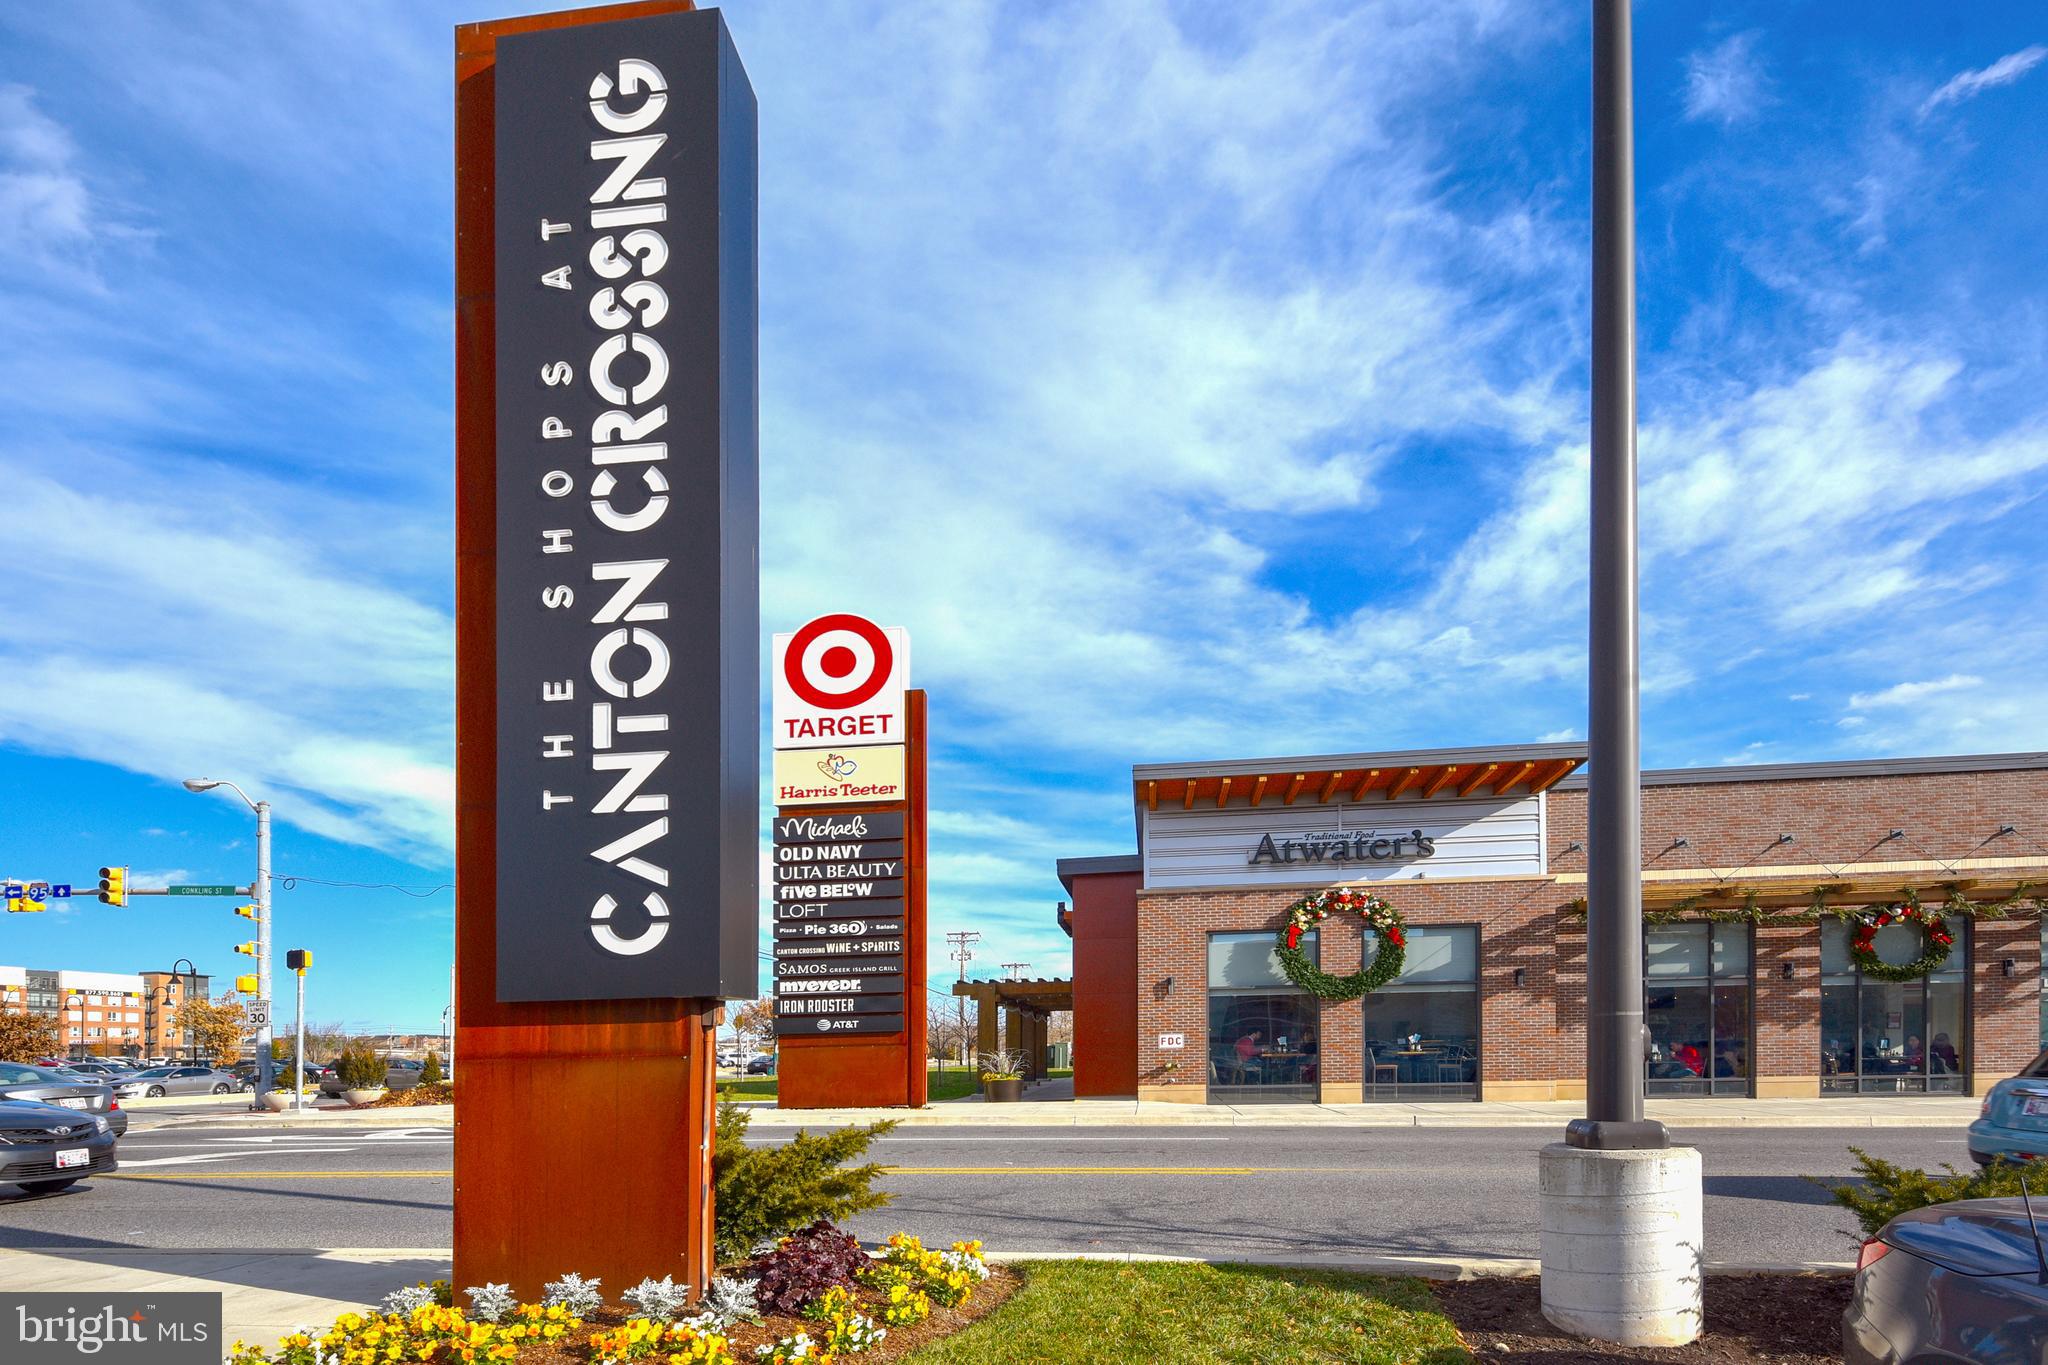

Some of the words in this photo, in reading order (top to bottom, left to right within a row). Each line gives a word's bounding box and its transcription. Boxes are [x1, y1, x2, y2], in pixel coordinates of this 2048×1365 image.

[541, 218, 572, 291] AT
[589, 57, 670, 532] CROSSING
[541, 360, 574, 609] SHOPS
[784, 714, 893, 739] TARGET
[541, 679, 574, 811] THE
[590, 558, 670, 956] CANTON
[780, 785, 838, 799] Harris
[840, 783, 897, 797] Teeter
[780, 815, 868, 840] Michaels
[1304, 832, 1352, 841] Traditional
[1354, 830, 1376, 839] Food
[780, 847, 814, 861] OLD
[817, 845, 863, 860] NAVY
[1248, 829, 1436, 864] Atwater's
[780, 865, 823, 880] ULTA
[826, 862, 897, 878] BEAUTY
[30, 887, 48, 899] 95
[181, 887, 213, 895] CONKLING
[215, 887, 223, 895] ST
[820, 883, 873, 898] BELOW
[780, 903, 829, 918] LOFT
[804, 924, 827, 935] Pie
[778, 963, 827, 975] SAMOS
[779, 1000, 805, 1014] IRON
[807, 998, 855, 1013] ROOSTER
[250, 1013, 266, 1024] 30
[832, 1020, 860, 1029] AT&T
